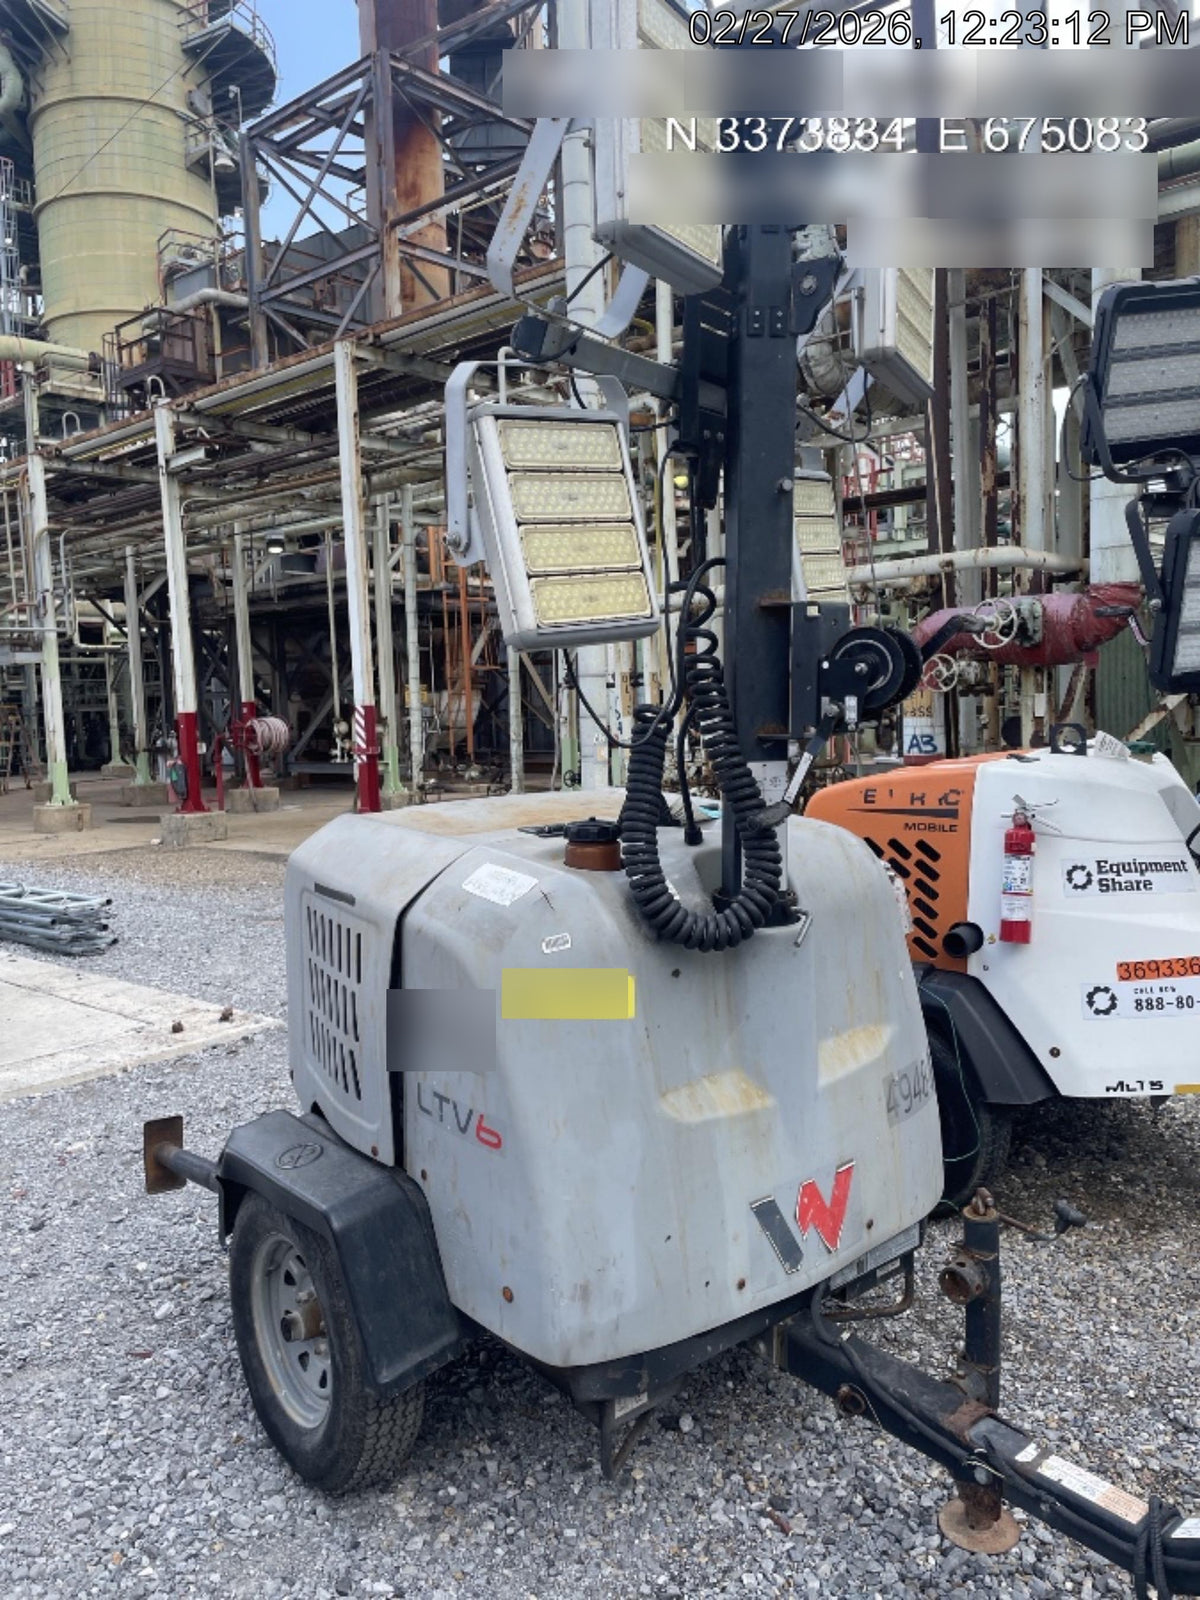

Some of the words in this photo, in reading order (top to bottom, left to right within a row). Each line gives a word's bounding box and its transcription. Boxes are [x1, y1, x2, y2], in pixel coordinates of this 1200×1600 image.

[907, 733, 938, 754] AB
[904, 822, 958, 833] MOBILE
[1096, 858, 1188, 877] Equipment
[1097, 877, 1153, 893] Share
[1118, 956, 1200, 981] 369336
[417, 1081, 503, 1150] LTV6
